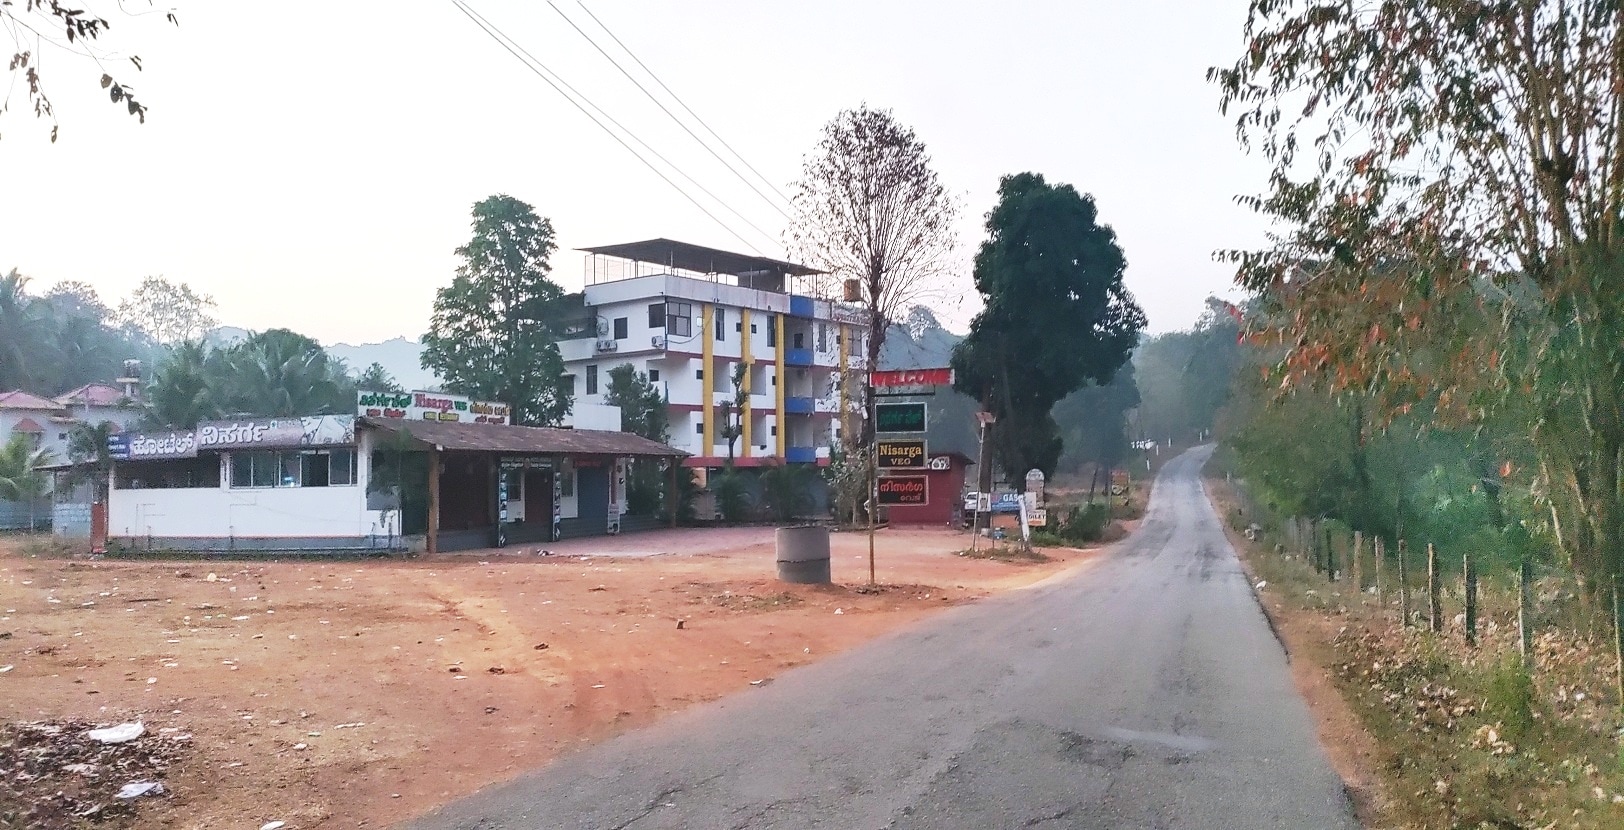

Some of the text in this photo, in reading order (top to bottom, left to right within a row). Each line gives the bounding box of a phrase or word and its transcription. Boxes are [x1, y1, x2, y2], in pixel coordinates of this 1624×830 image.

[414, 393, 454, 413] Nisarga
[133, 432, 194, 455] ಹೋಟೆಲ್
[200, 422, 269, 446] ನಿಸರ್ಗ
[879, 444, 923, 458] Nisarga
[880, 480, 924, 492] നിസർഗ
[1003, 493, 1019, 502] GAS
